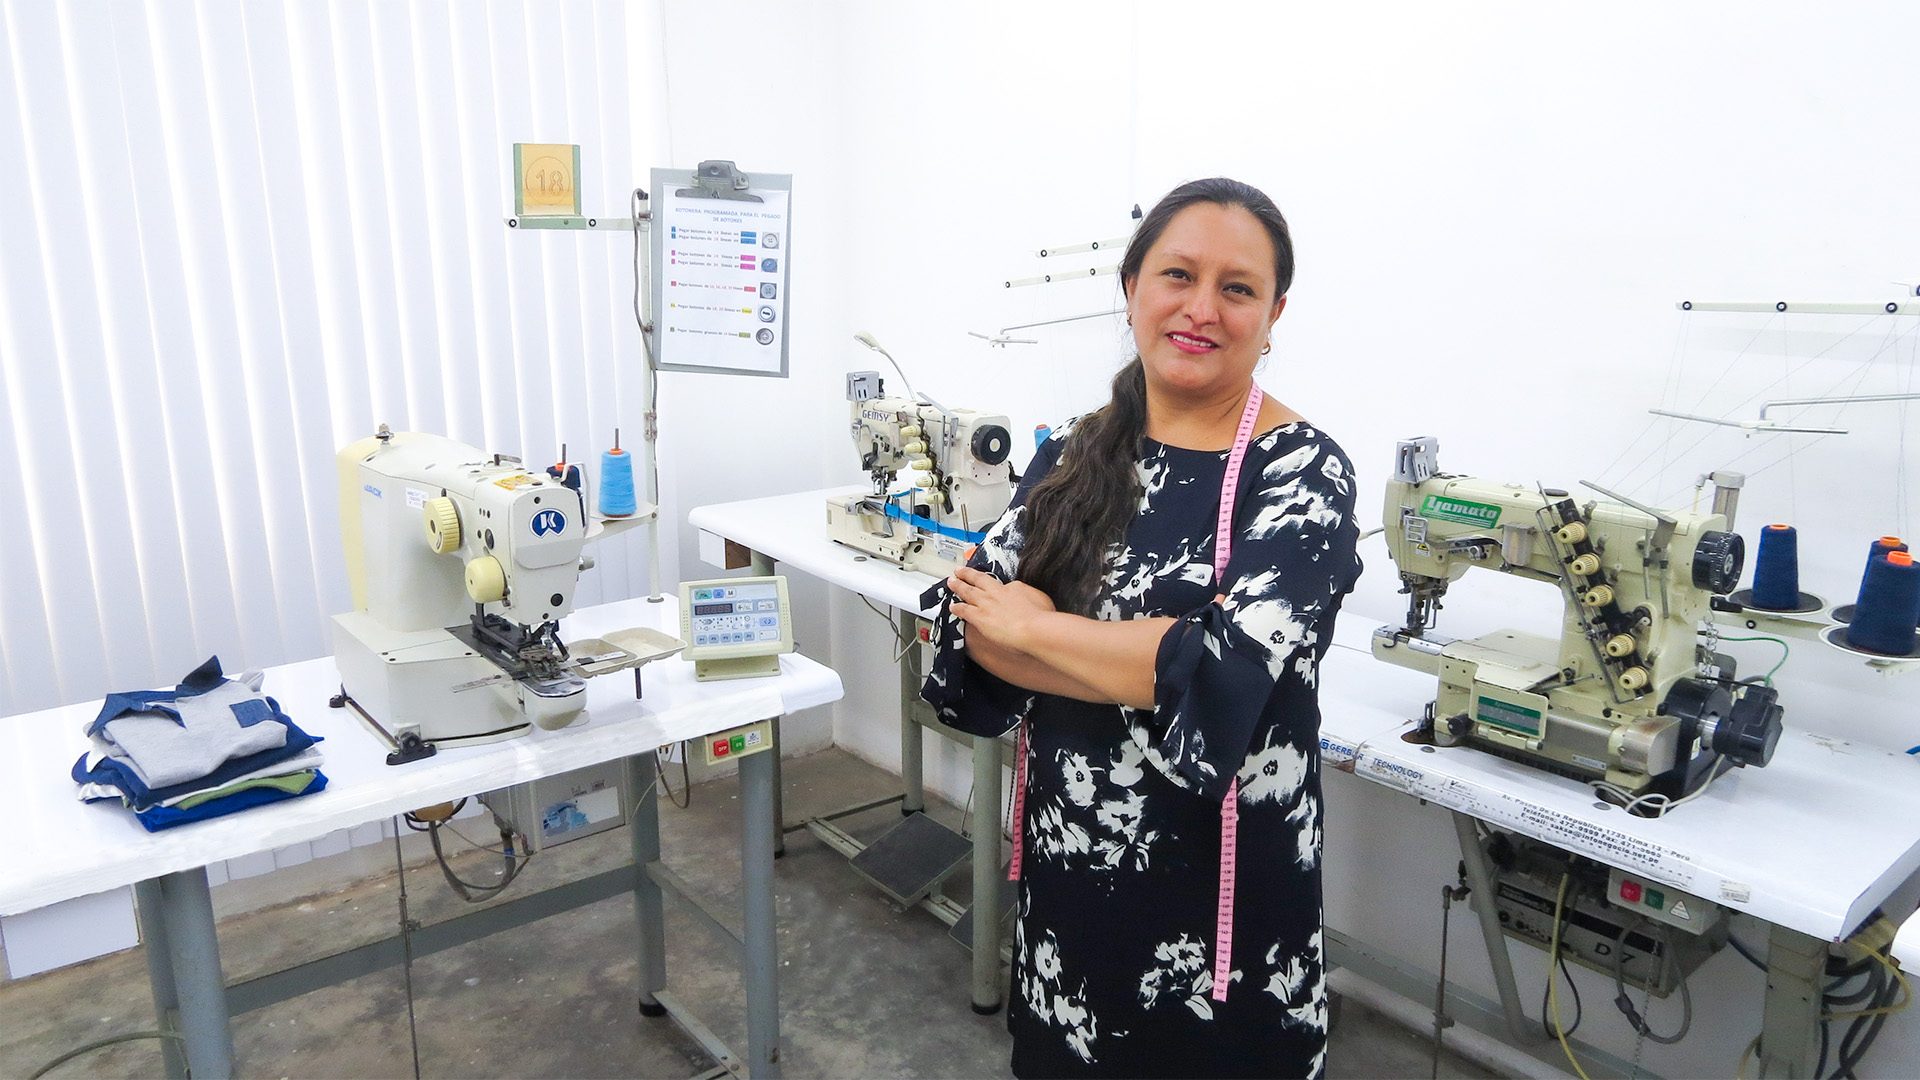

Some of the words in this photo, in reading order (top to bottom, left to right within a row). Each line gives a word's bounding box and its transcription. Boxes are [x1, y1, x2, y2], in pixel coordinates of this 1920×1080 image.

[536, 169, 563, 196] 18
[862, 410, 889, 422] GEMSY
[1330, 743, 1364, 760] GERBR
[1373, 757, 1425, 781] TECHNOLOGY
[1629, 836, 1648, 847] Lima
[1595, 942, 1611, 956] D
